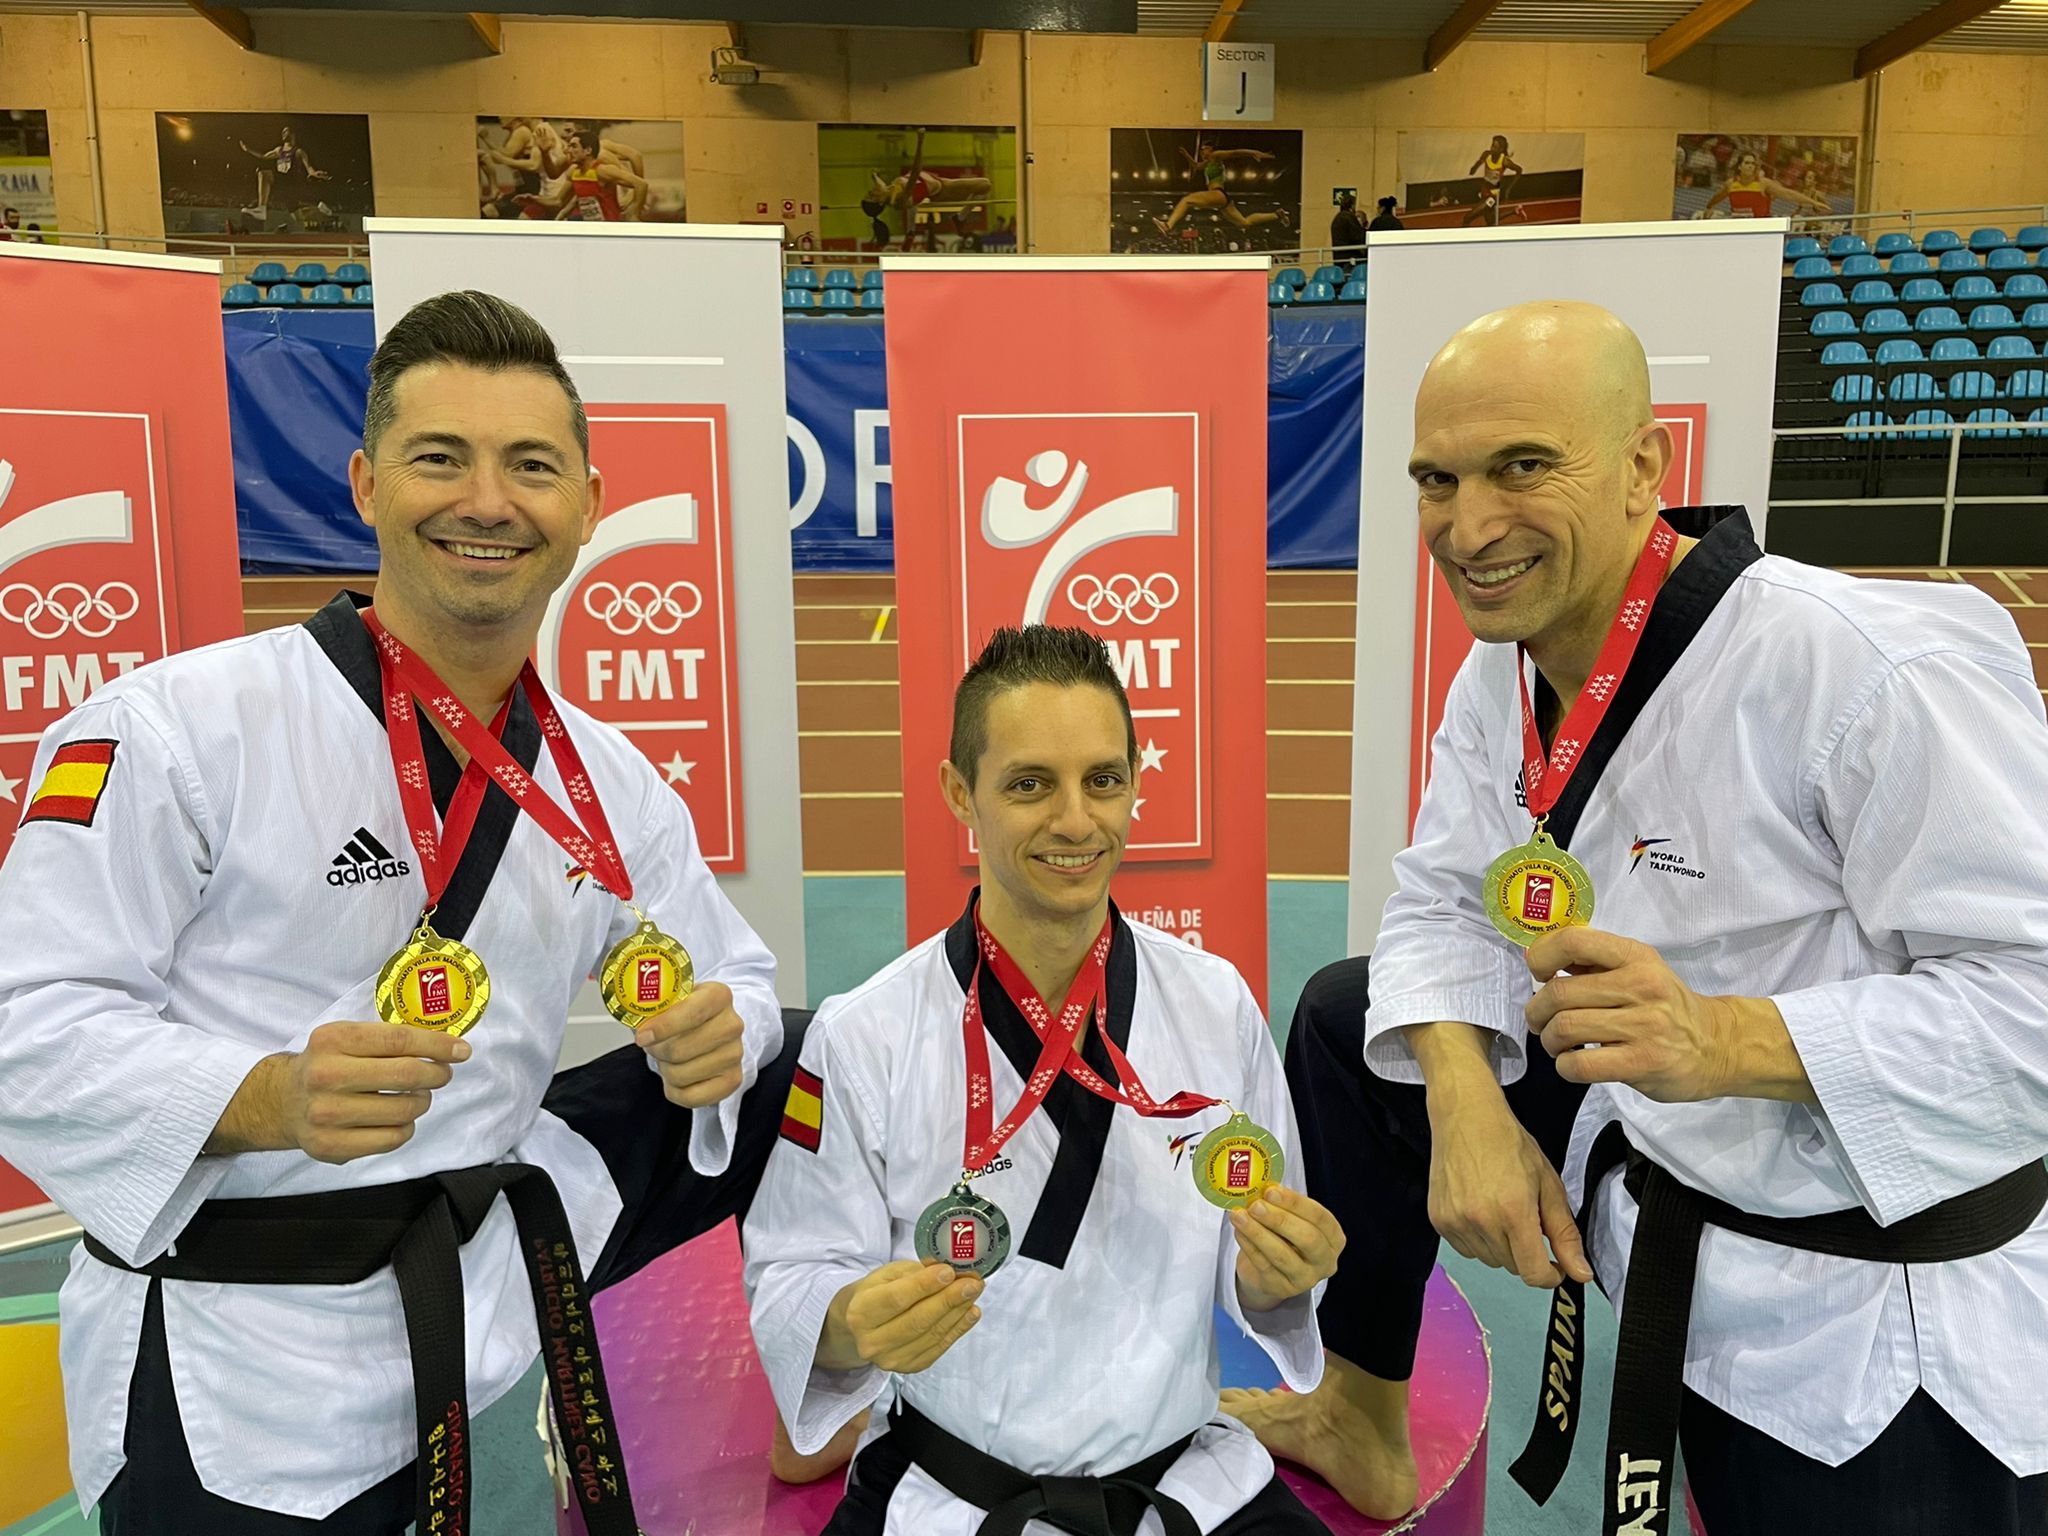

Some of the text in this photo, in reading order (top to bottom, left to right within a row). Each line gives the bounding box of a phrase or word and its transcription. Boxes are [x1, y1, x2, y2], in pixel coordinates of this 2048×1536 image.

[1217, 49, 1266, 61] SECTOR
[1236, 72, 1246, 114] J
[586, 648, 706, 702] FMT
[1103, 639, 1180, 689] MT
[2, 652, 145, 711] FMT
[1650, 851, 1685, 864] WORLD
[326, 860, 410, 886] adidas
[1649, 862, 1706, 880] TAEKWONDO
[1502, 868, 1524, 904] CAMPEONATO
[1553, 869, 1573, 890] MADRID
[1180, 908, 1202, 928] DE
[1513, 916, 1560, 931] DICIEMBRE 2021
[635, 949, 650, 957] VILLA
[396, 966, 413, 1009] CAMPEONATO
[414, 957, 431, 967] VILLA
[442, 957, 465, 973] MADRID
[449, 1009, 464, 1021] 2021
[1546, 1286, 1576, 1432] SPAIN
